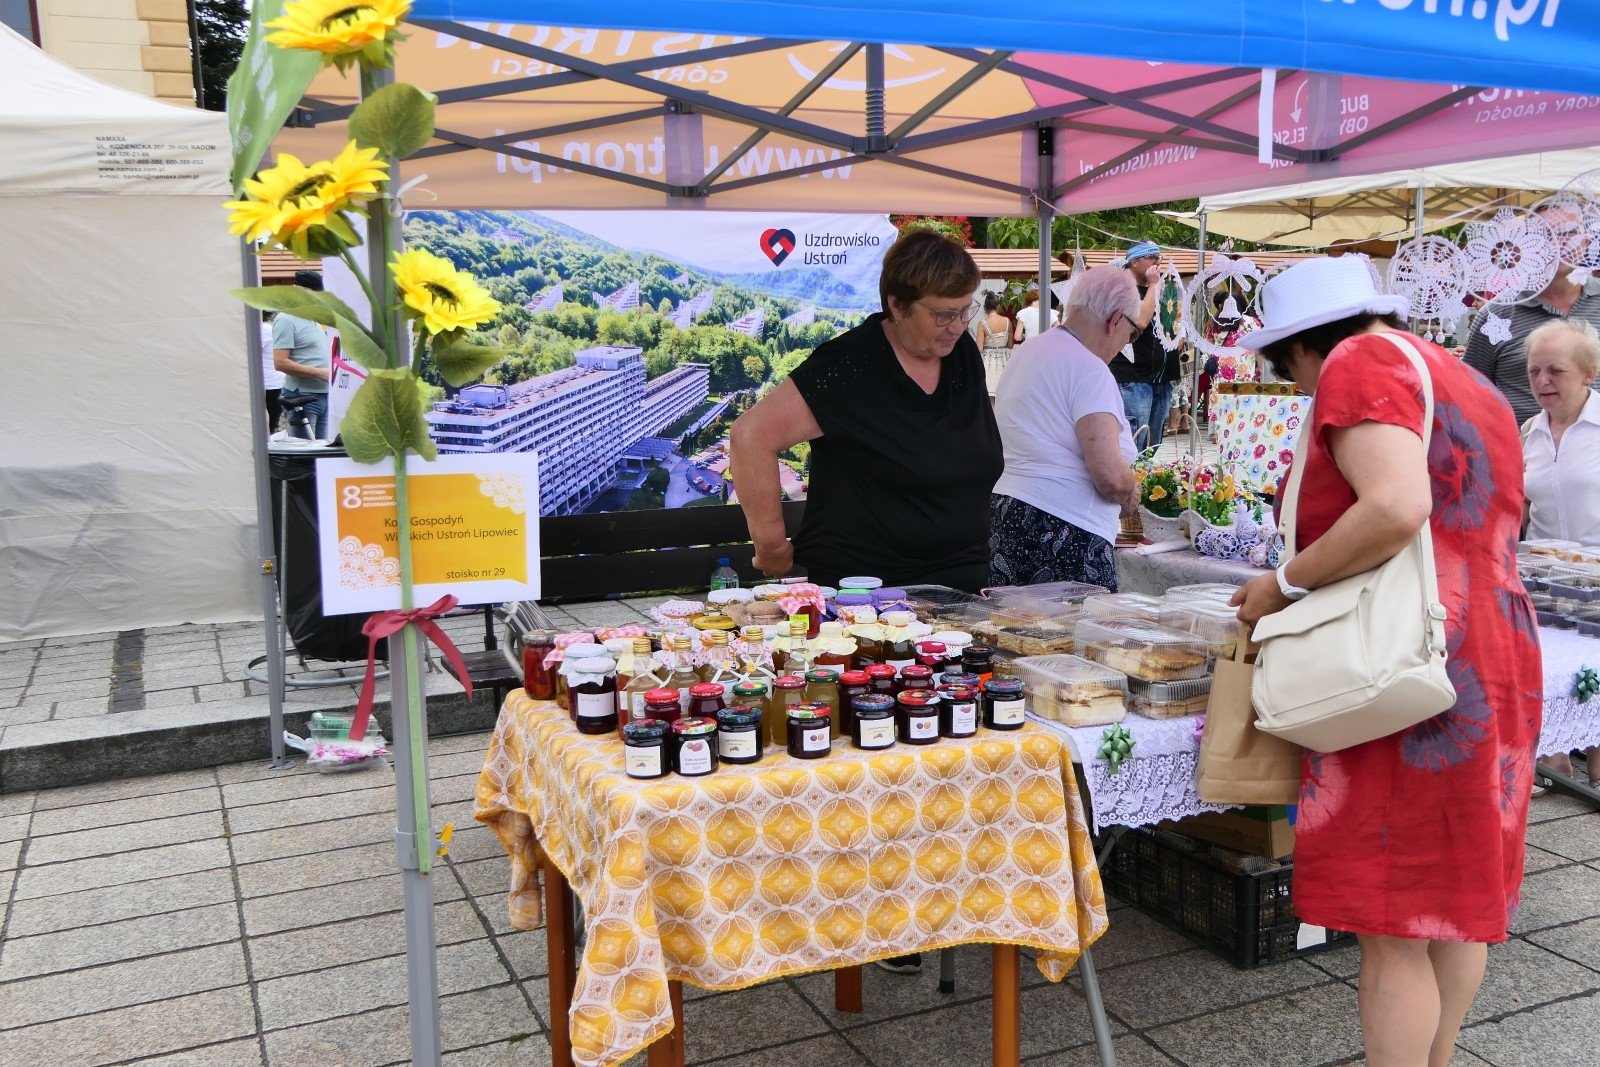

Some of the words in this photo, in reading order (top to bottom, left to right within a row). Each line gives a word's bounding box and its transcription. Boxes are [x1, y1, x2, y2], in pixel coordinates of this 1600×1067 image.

[804, 232, 880, 247] Uzdrowisko
[803, 250, 848, 265] Ustroń
[342, 485, 362, 509] 8
[410, 514, 464, 527] Gospodyń
[384, 530, 434, 542] Wiskich
[436, 528, 471, 540] Ustroń
[473, 527, 519, 539] Lipowiec
[446, 568, 480, 579] stoisko
[493, 567, 505, 576] 29
